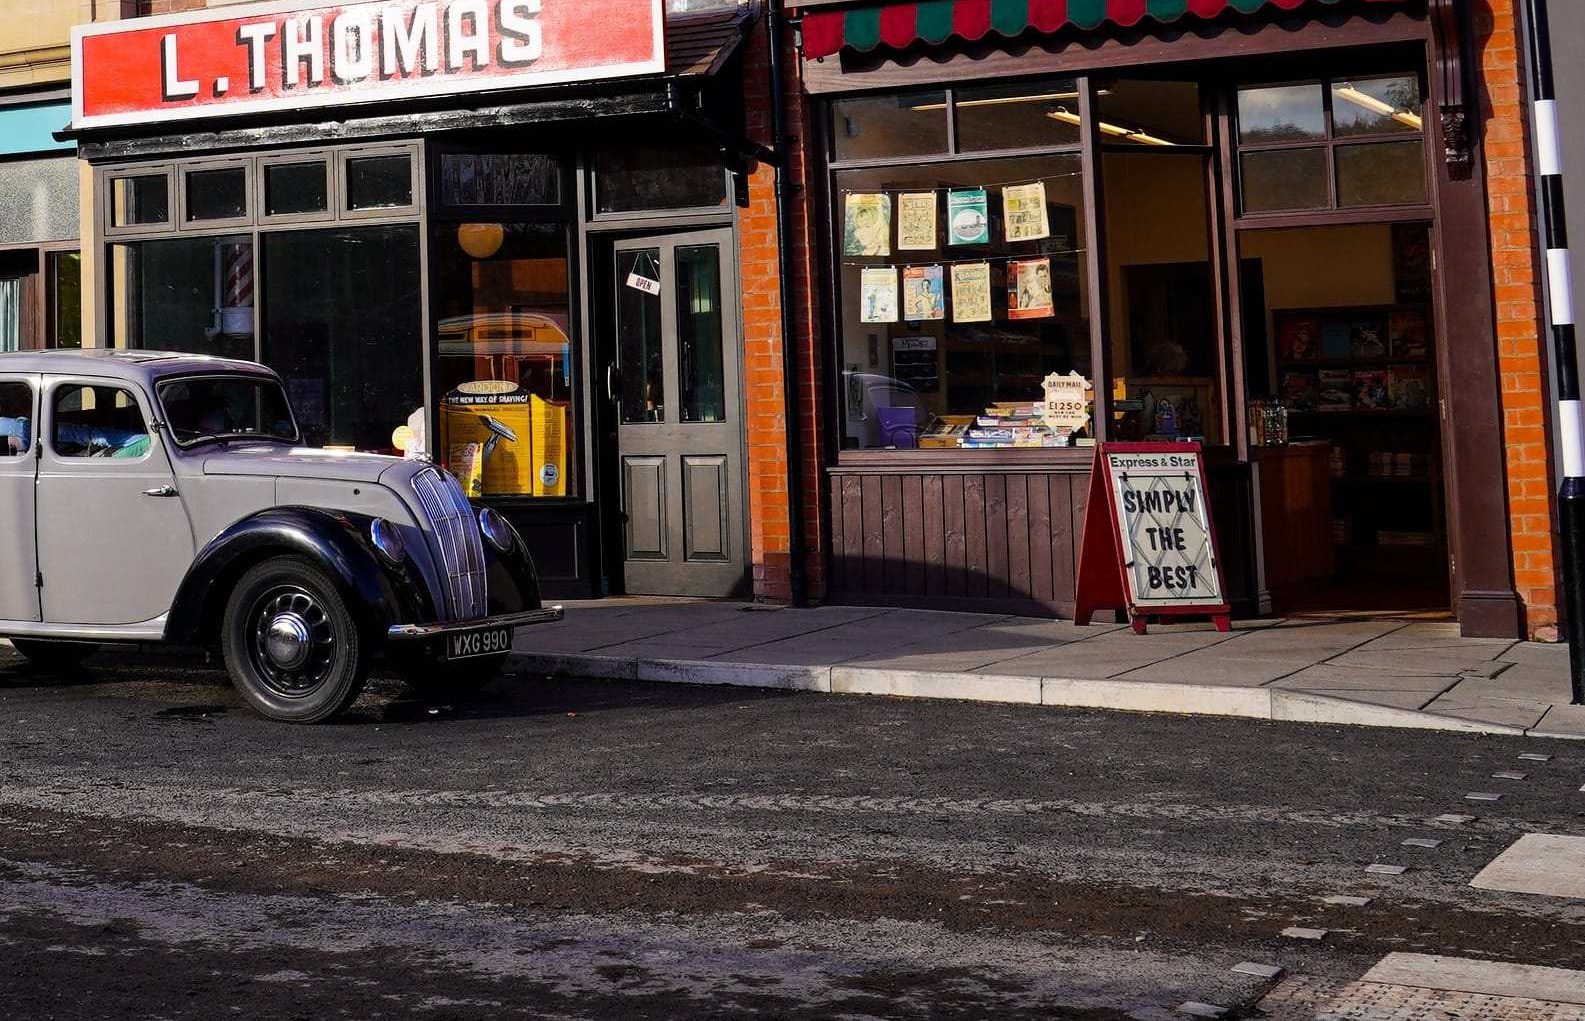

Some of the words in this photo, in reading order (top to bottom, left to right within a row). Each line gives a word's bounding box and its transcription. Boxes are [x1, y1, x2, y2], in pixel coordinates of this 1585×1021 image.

[635, 277, 653, 290] OPEN
[1049, 401, 1082, 411] £1250
[1111, 457, 1159, 469] Express
[1161, 459, 1168, 467] &
[1170, 456, 1196, 467] Star
[1123, 488, 1196, 514] SIMPLY
[1145, 526, 1187, 551] THE
[1147, 565, 1198, 590] BEST
[454, 633, 480, 656] WXG
[483, 629, 508, 651] 990
